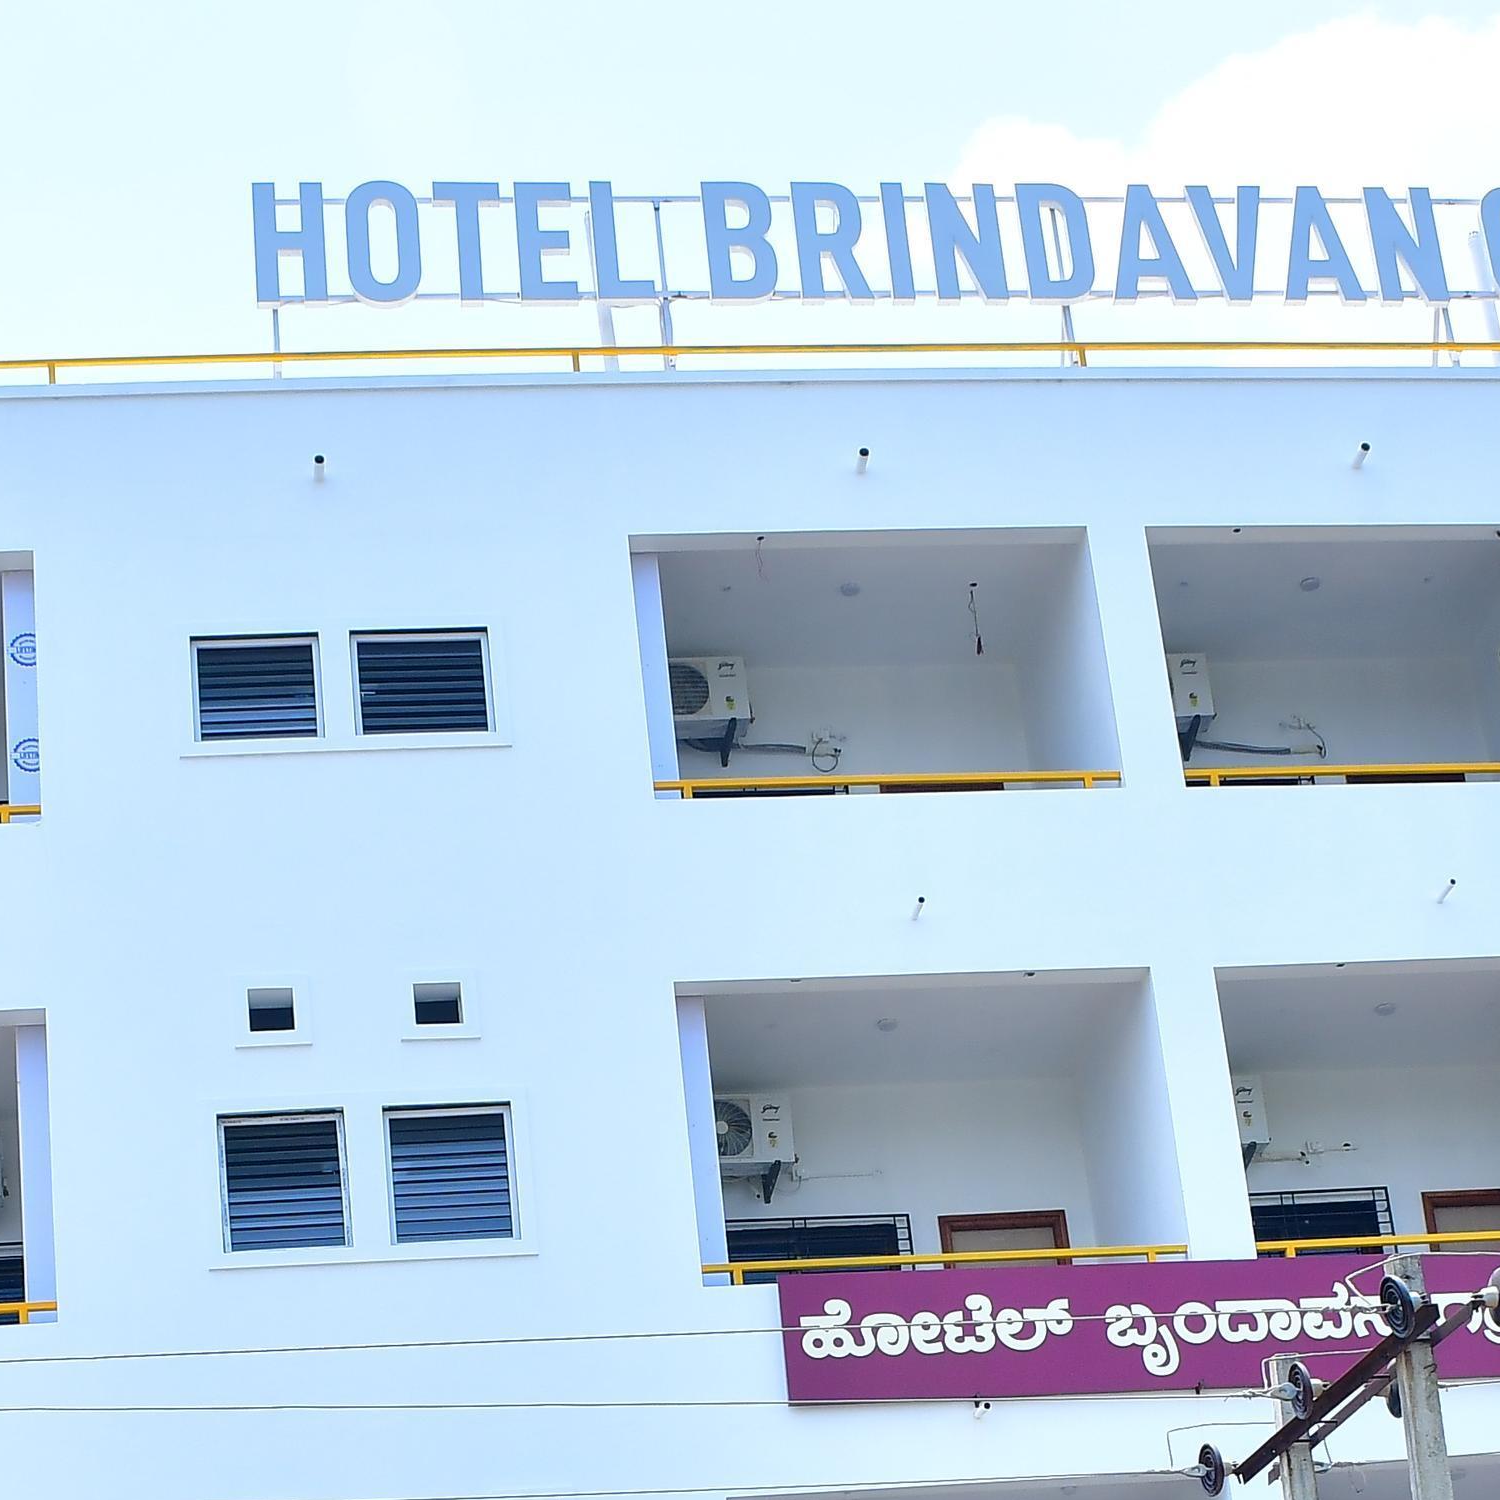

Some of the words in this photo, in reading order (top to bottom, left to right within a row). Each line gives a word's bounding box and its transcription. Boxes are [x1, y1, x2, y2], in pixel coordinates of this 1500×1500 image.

[250, 179, 659, 306] HOTEL
[699, 181, 1453, 308] BRINDAVAN
[798, 1292, 1075, 1360] ಹೋಟೆಲ್
